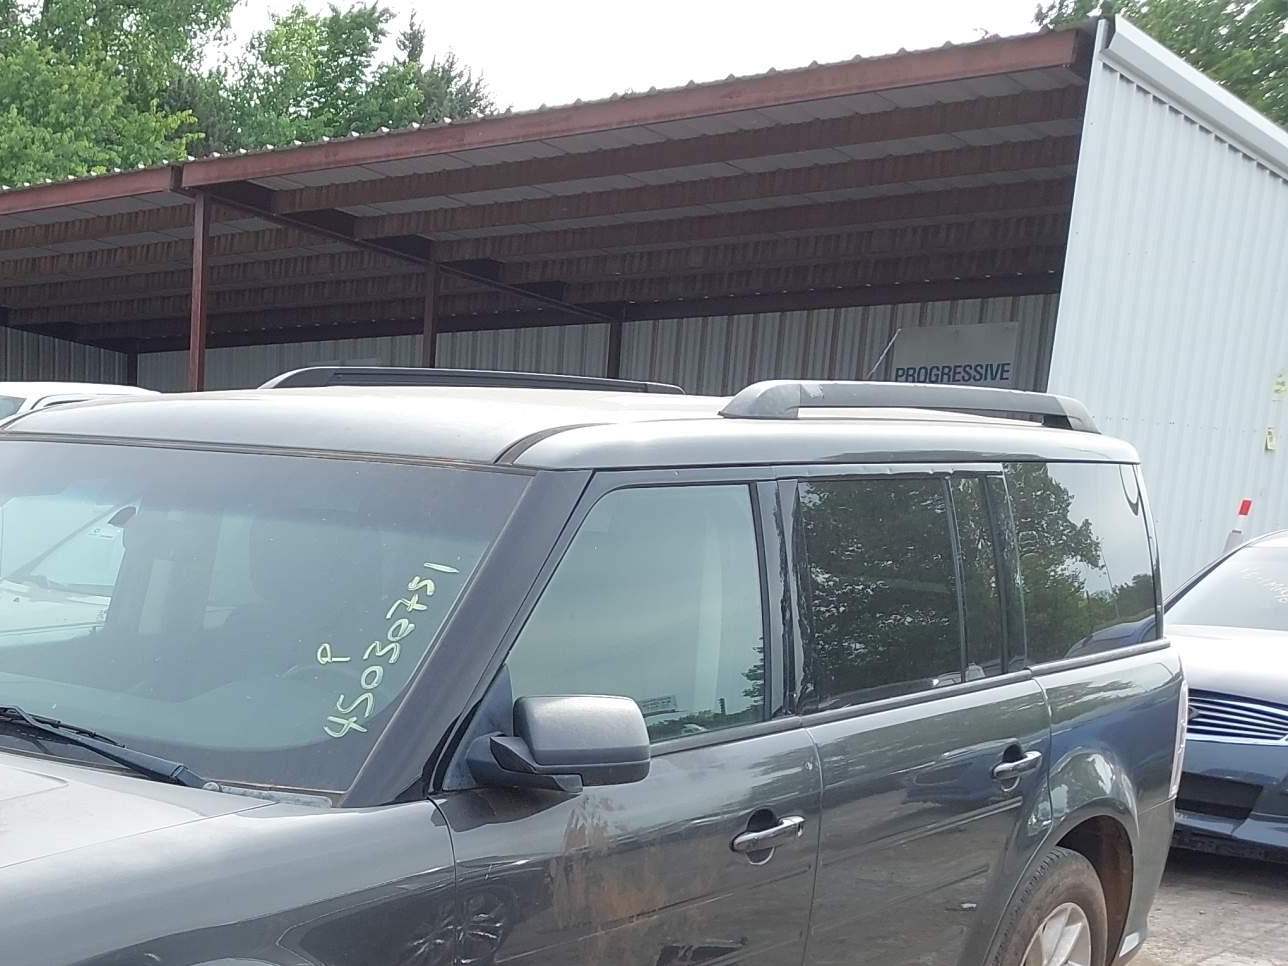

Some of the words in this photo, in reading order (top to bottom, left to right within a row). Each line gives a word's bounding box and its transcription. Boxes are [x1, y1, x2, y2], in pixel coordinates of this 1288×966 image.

[895, 362, 1011, 384] PROGRESSIVE
[316, 642, 352, 665] P
[323, 561, 460, 738] 45030751
